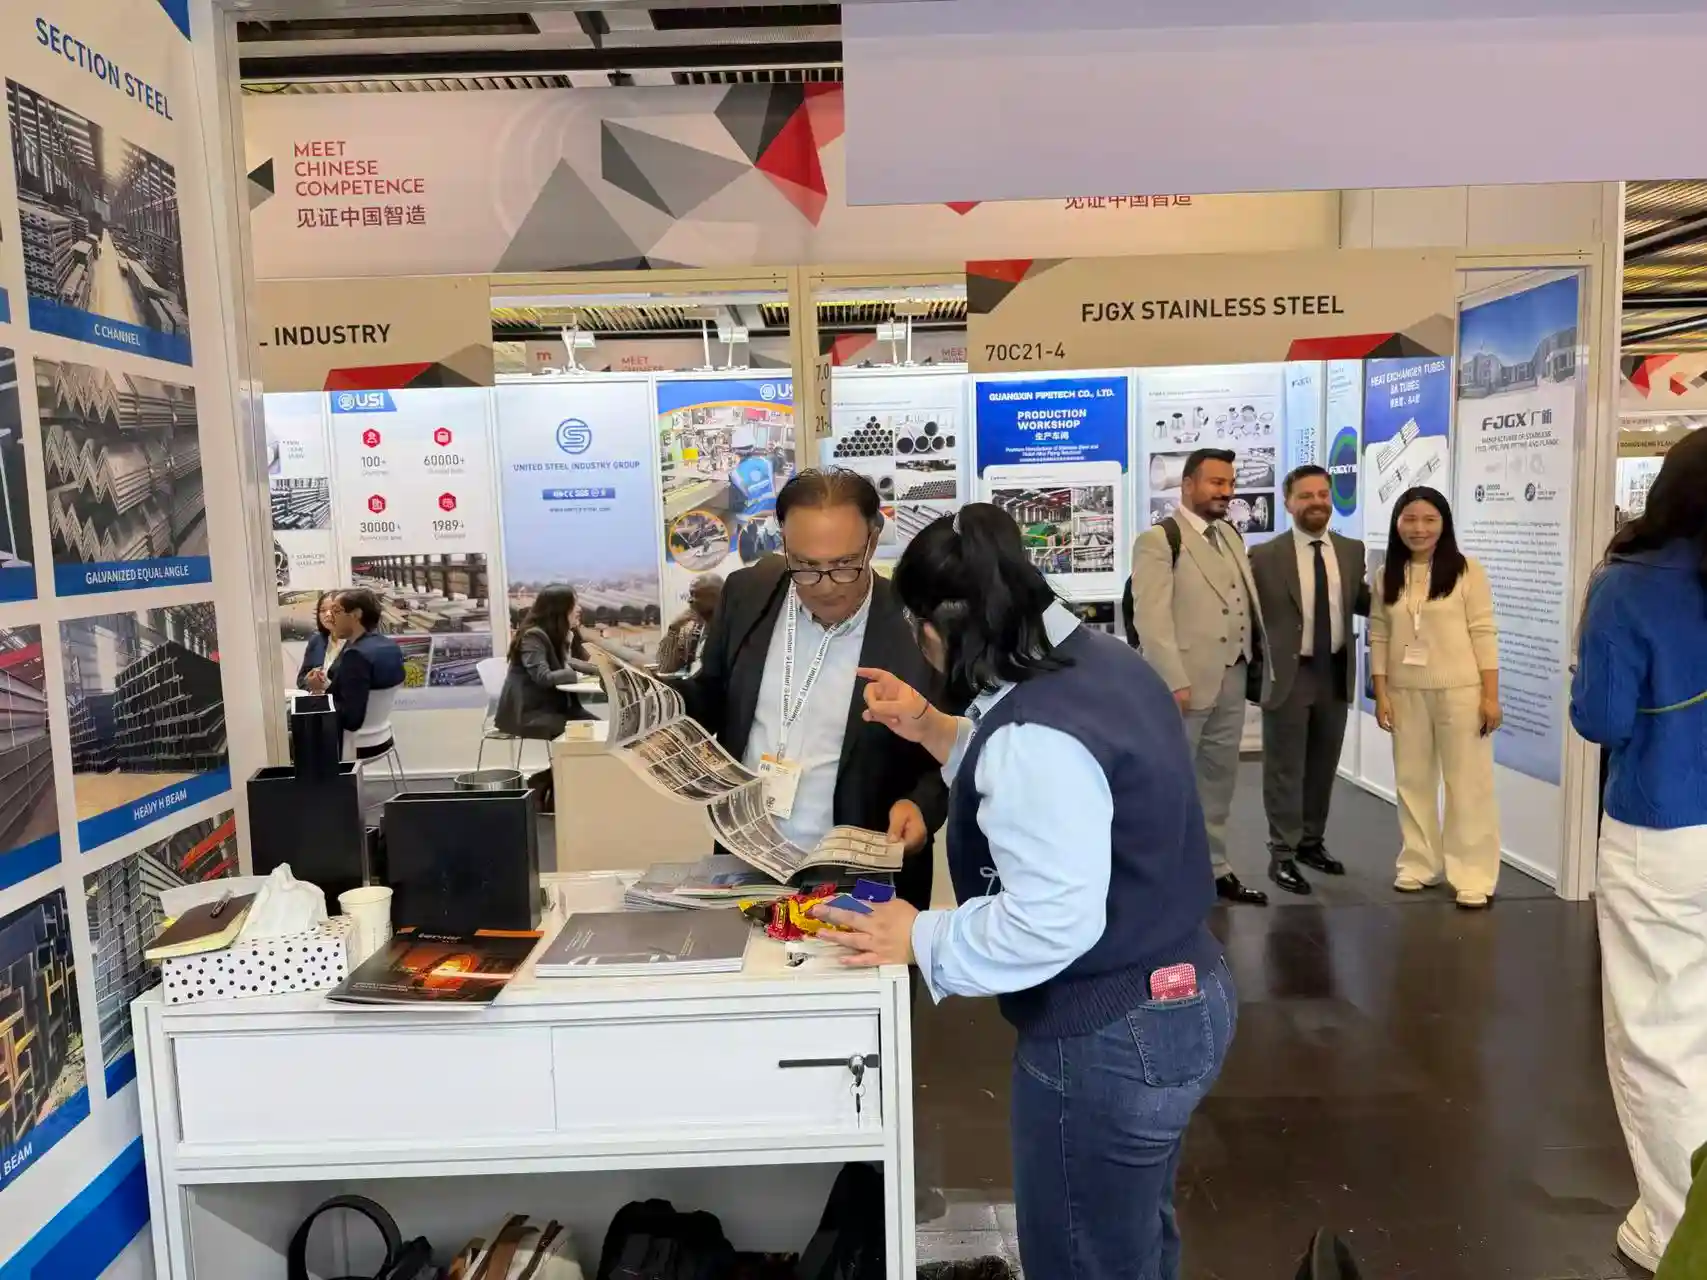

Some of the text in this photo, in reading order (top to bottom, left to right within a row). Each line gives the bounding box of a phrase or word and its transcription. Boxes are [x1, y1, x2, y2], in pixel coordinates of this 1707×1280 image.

[36, 17, 173, 121] SECTION STEEL
[294, 141, 346, 157] MEET
[294, 160, 378, 177] CHINESE
[295, 178, 425, 196] COMPETENCE
[296, 205, 427, 228] 见证中国智造
[1081, 295, 1344, 323] FJGX STAINLESS STEEL
[94, 323, 141, 346] C CHANNEL
[274, 323, 391, 346] INDUSTRY
[985, 343, 1066, 362] 70C21-4
[815, 362, 830, 381] 7.0
[820, 388, 826, 406] C
[989, 392, 1033, 402] GUANGXIN
[1035, 390, 1076, 400] PIPETECH
[1017, 409, 1087, 420] PRODUCTION
[1482, 412, 1527, 431] FJGX
[1017, 420, 1081, 430] WORKSHOP
[424, 454, 465, 466] 60000+
[513, 460, 640, 471] UNITED STEEL INDUSTRY GROUP
[86, 564, 189, 585] GALVANIZED EQUAL ANGLE
[134, 789, 187, 821] HEAVY H BEAM
[3, 1141, 33, 1176] BEAM
